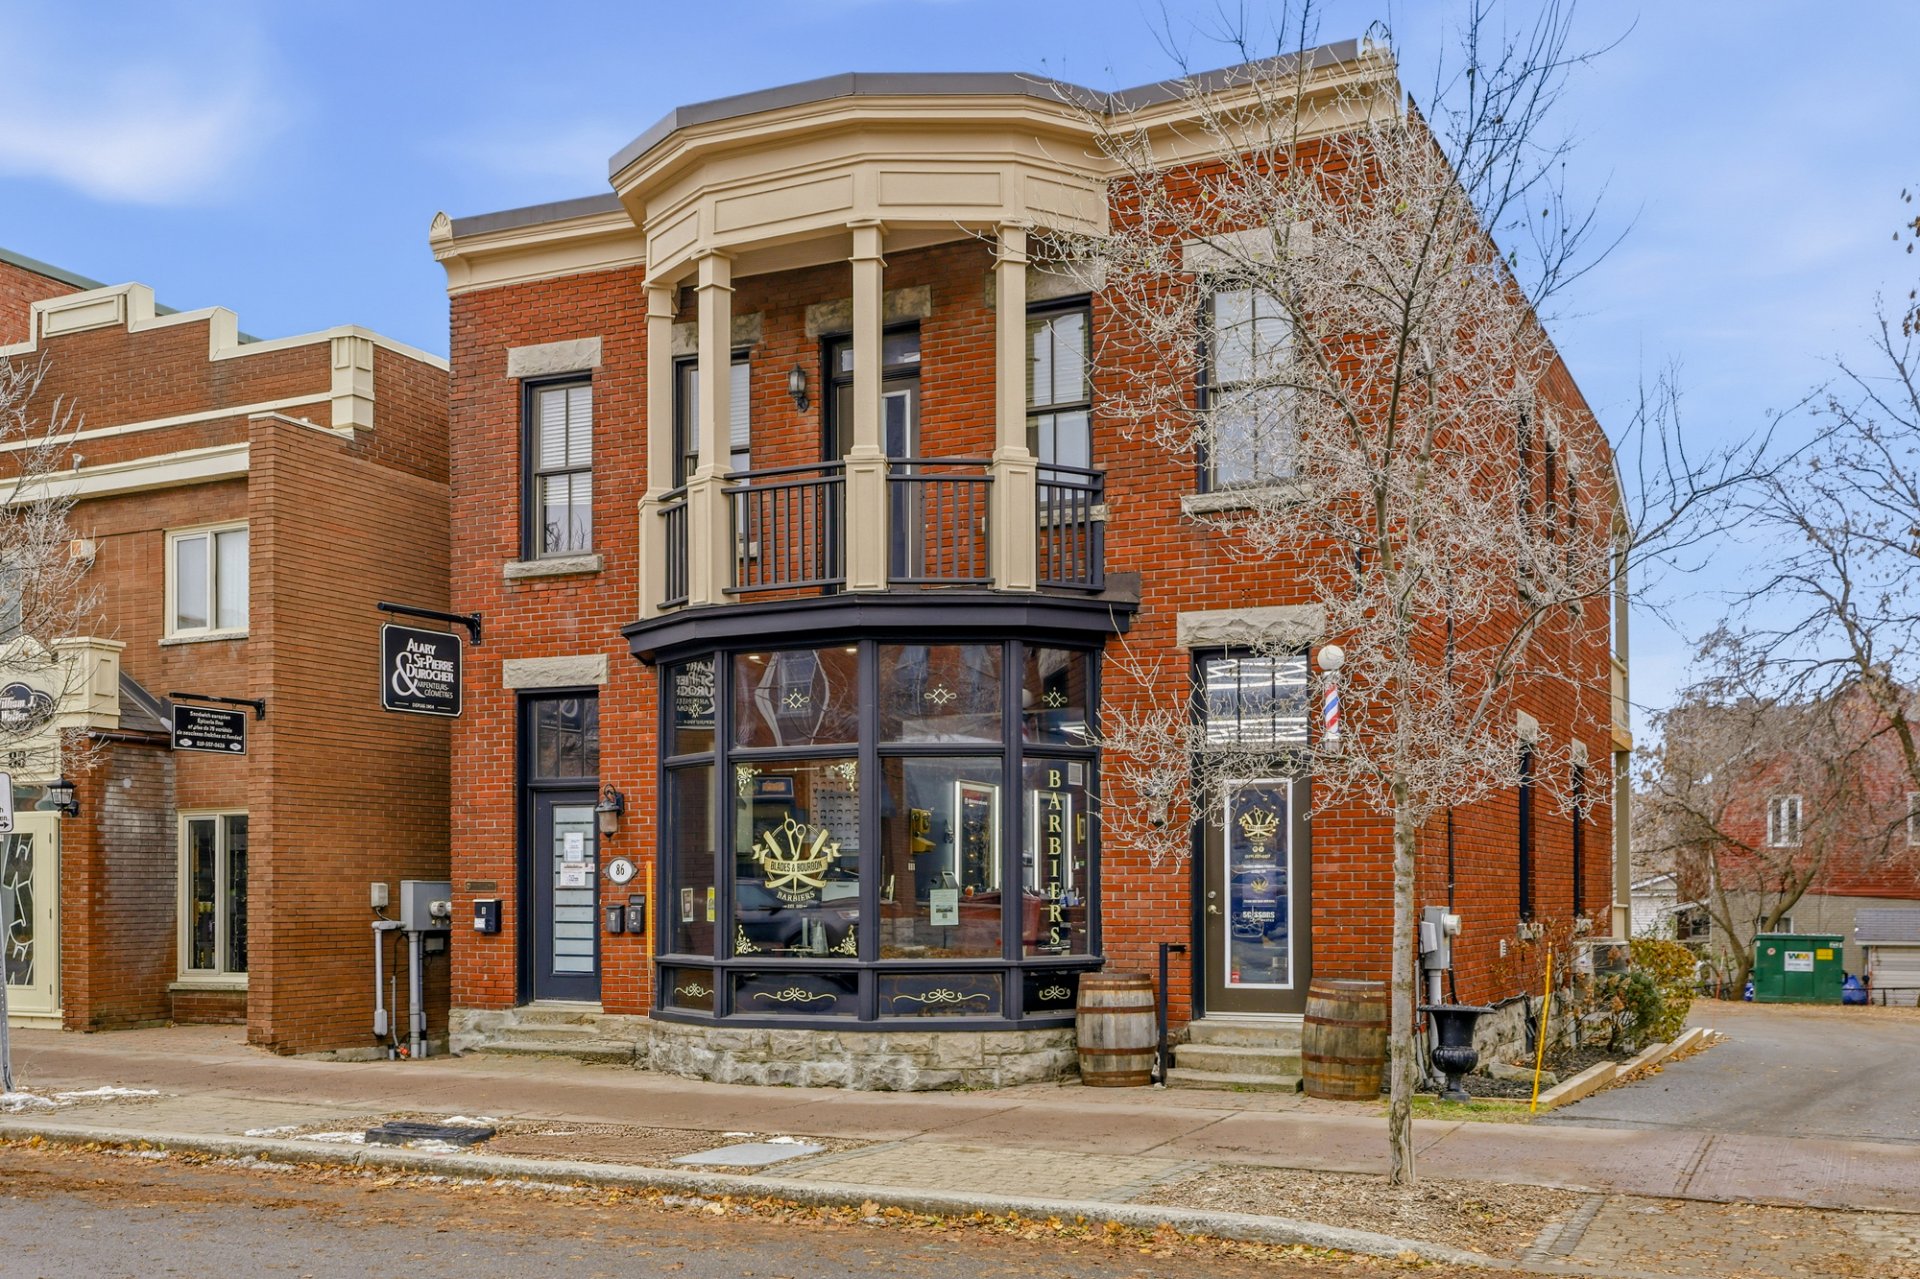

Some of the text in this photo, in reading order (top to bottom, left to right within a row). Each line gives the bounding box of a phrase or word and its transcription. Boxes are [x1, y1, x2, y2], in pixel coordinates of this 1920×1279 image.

[406, 638, 436, 655] ALARY
[414, 654, 454, 672] ST-PIERRE
[392, 652, 426, 698] &
[406, 664, 454, 682] DUROCHER
[1048, 770, 1063, 944] BARBIERS
[616, 864, 625, 875] 86
[770, 860, 822, 872] BLADES & BOURBON
[776, 890, 815, 902] BARBIERS
